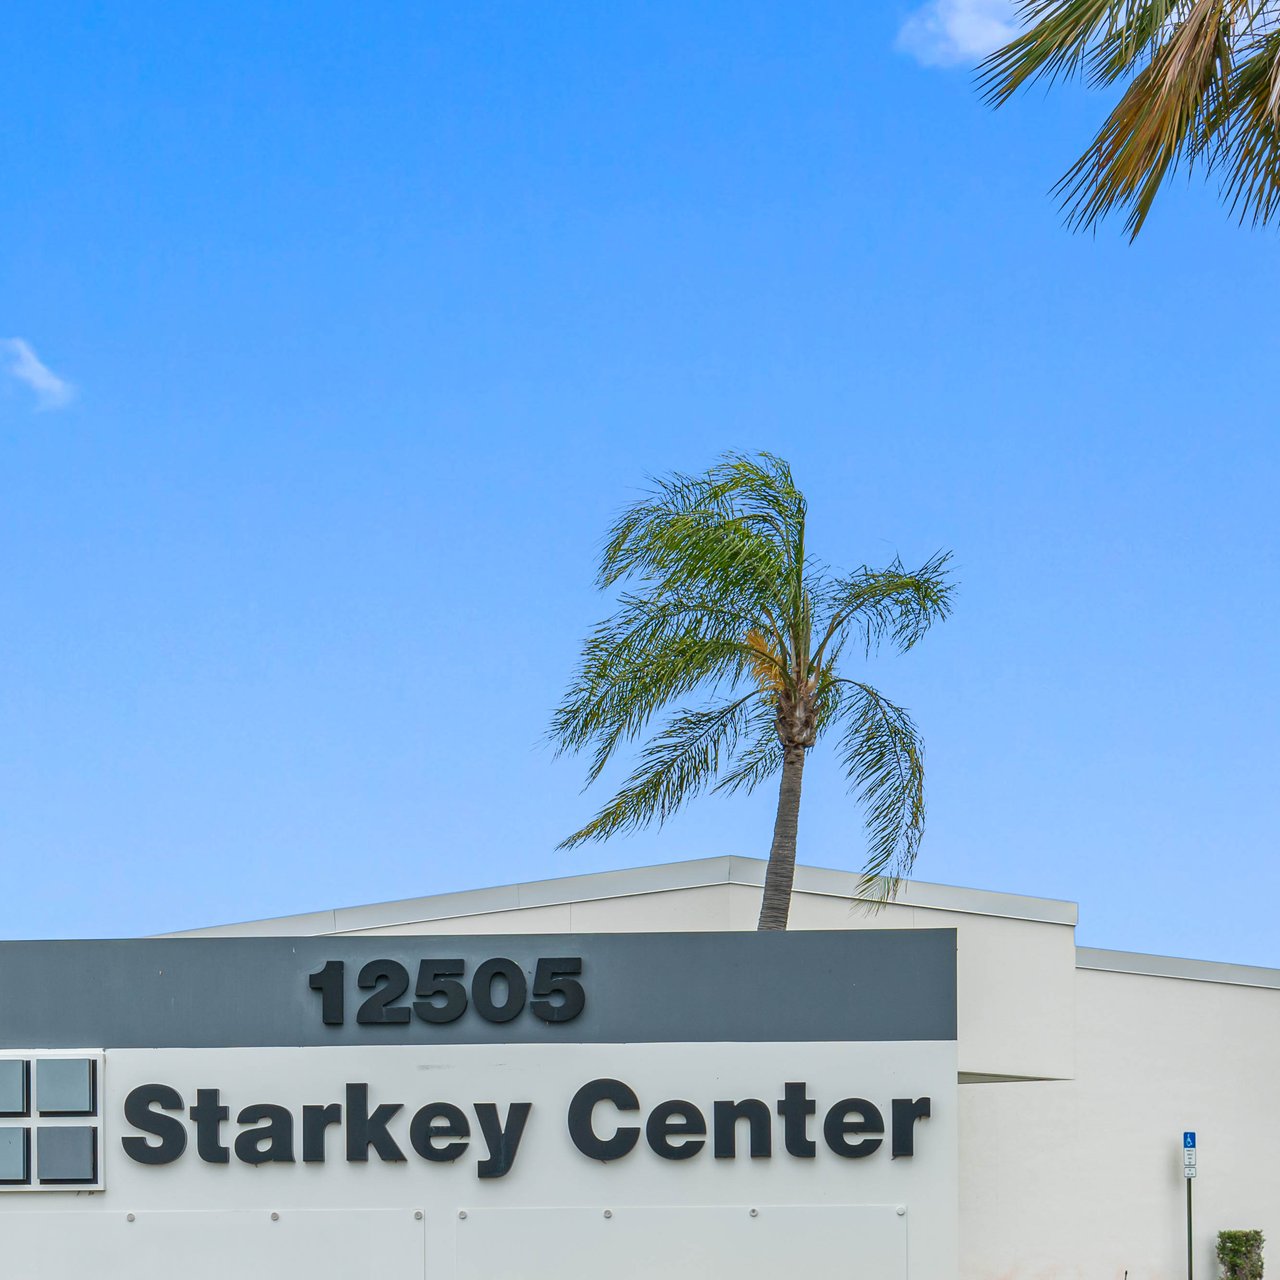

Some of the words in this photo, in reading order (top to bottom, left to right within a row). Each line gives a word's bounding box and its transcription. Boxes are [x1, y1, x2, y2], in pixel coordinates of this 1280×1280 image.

[308, 957, 586, 1025] 12505
[121, 1082, 533, 1179] Starkey
[567, 1077, 932, 1160] Center
